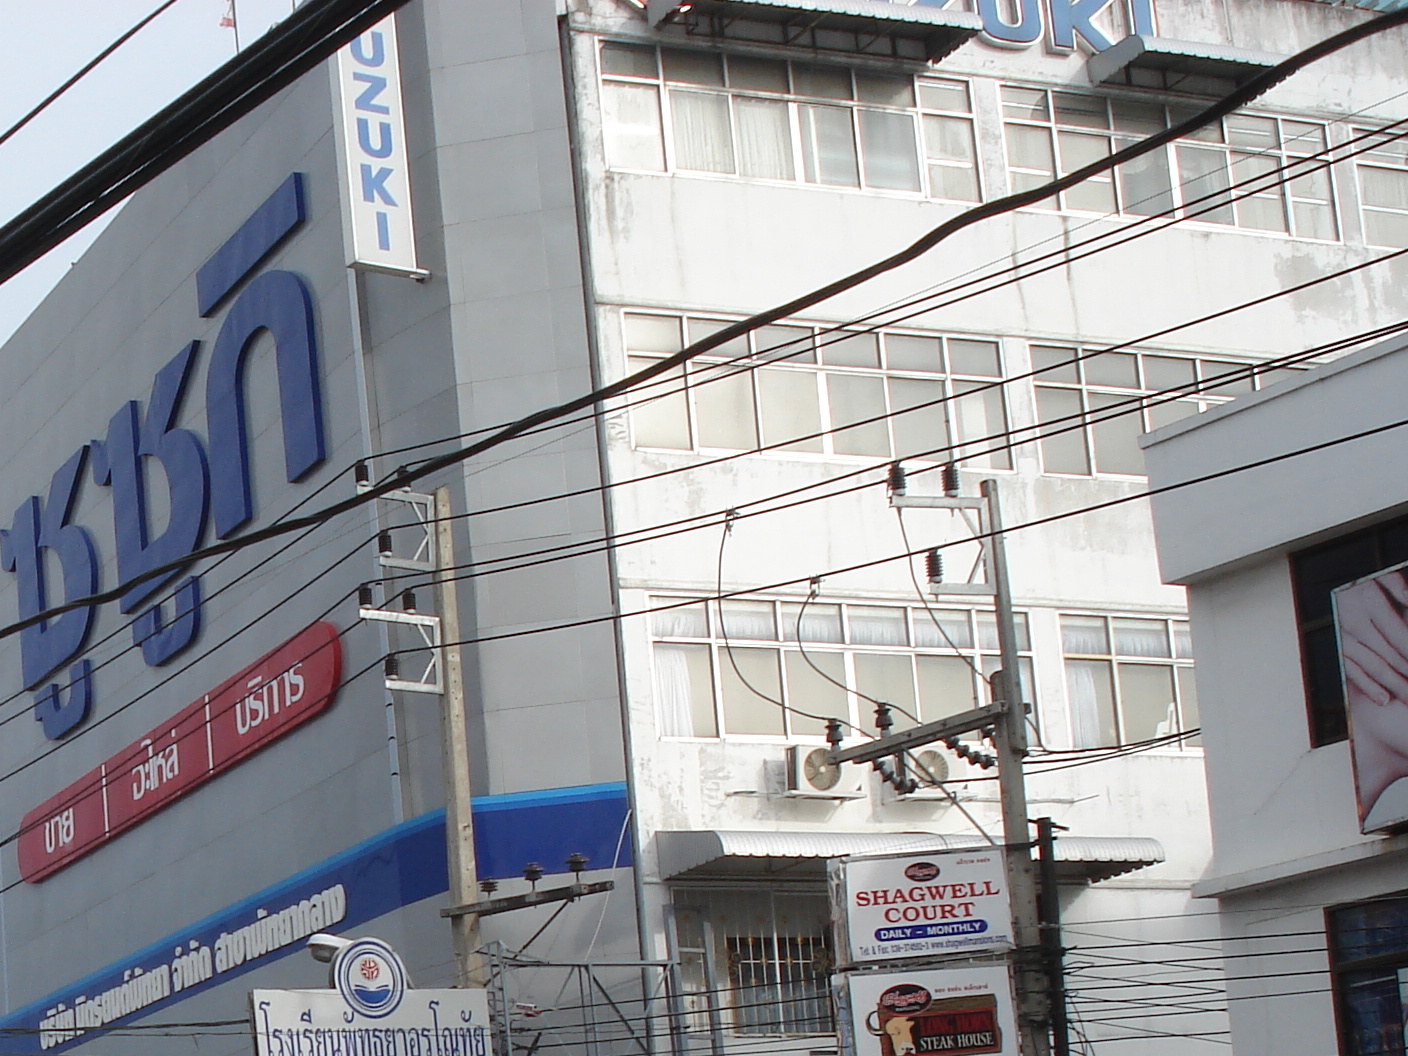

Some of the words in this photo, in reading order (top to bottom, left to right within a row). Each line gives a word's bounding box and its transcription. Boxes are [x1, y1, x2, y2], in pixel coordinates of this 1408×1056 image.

[956, 0, 1155, 52] UKI
[350, 28, 399, 252] UZUKI
[236, 660, 306, 735] บริการ
[131, 729, 180, 801] อะไหล่
[44, 806, 76, 855] ขาย
[856, 881, 1000, 907] SHAGWELL
[884, 902, 976, 923] COURT
[880, 927, 912, 940] DAILY
[927, 922, 981, 936] MONTHLY
[171, 939, 213, 993] จำกัด
[920, 1035, 955, 1051] STEAK
[957, 1031, 994, 1048] HOUSE
